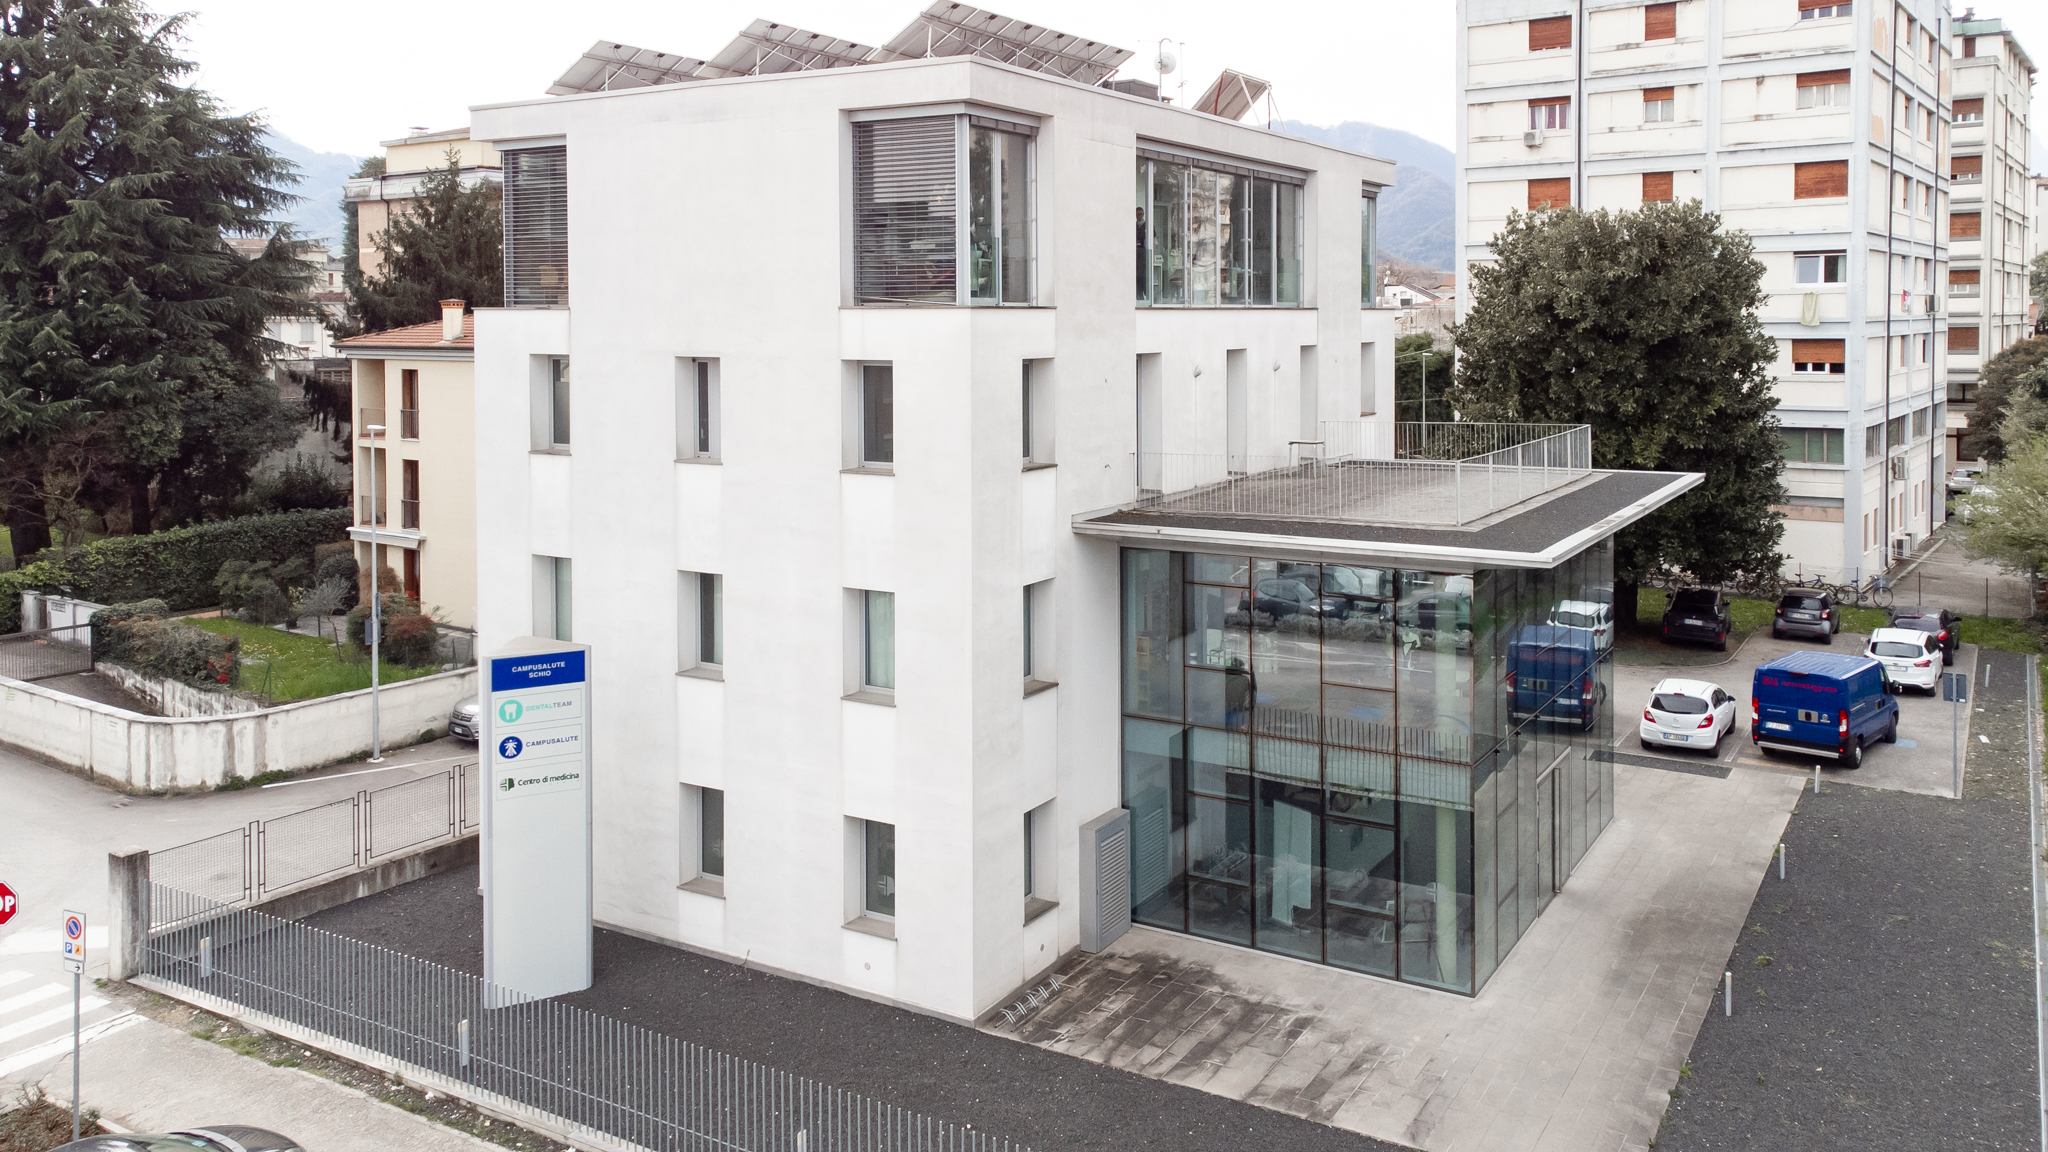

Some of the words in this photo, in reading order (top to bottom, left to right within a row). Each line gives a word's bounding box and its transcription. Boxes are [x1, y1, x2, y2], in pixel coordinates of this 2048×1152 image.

[512, 661, 566, 673] CAMPUSALUTE
[528, 670, 552, 678] SCHIO
[525, 700, 573, 712] DENTALTEAM
[525, 735, 579, 748] CAMPUSALUTE
[517, 778, 541, 786] Centro
[542, 775, 549, 783] di
[549, 772, 580, 782] medicina
